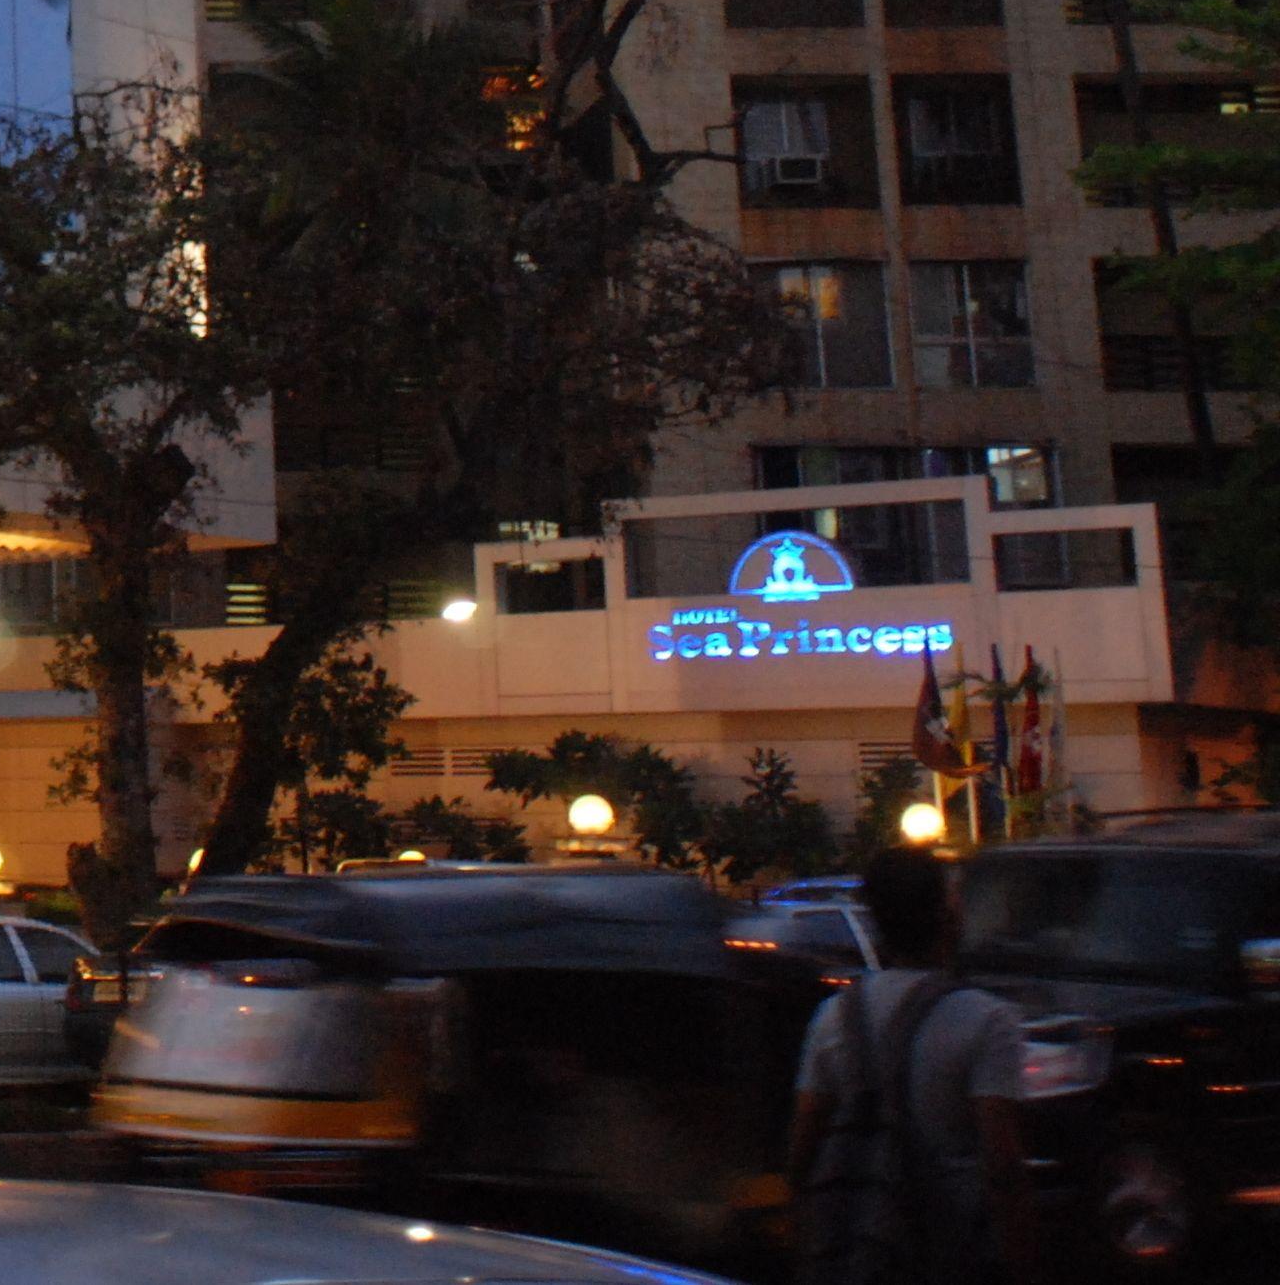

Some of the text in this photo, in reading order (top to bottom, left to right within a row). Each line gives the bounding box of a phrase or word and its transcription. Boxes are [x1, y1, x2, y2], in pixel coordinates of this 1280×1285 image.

[672, 608, 738, 625] HOTEL
[648, 619, 953, 661] Sea Princess
